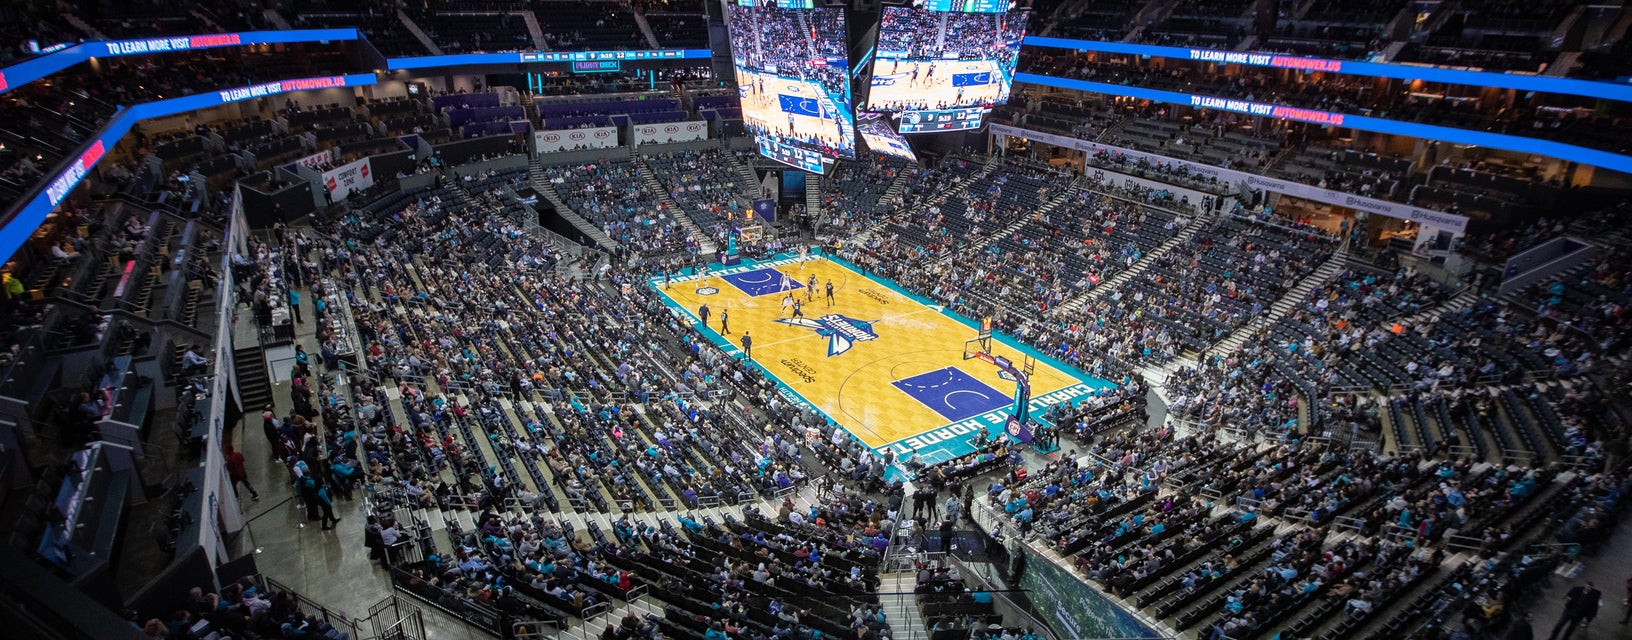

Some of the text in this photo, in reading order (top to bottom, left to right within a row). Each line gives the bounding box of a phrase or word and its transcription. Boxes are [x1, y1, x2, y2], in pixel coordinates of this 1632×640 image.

[106, 42, 120, 54] TO
[120, 41, 148, 54] LEARN
[147, 40, 170, 51] MORE
[170, 38, 190, 50] VISIT
[1190, 50, 1341, 71] TO LEARN MORE VISIT AUTOMOWER.US
[220, 77, 345, 102] TO LEARN MORE VISIT AUTOMOWER.US
[1191, 96, 1344, 125] TO LEARN MORE VISIT AUTOMOWER.US
[1254, 178, 1285, 190] Husqvarna
[1354, 198, 1392, 212] Husqvarna
[1421, 211, 1463, 226] Husqvarna
[820, 314, 876, 341] HORNETS
[781, 359, 816, 383] Spectrum
[790, 358, 816, 374] CENTER
[983, 384, 1096, 424] CHARLTE
